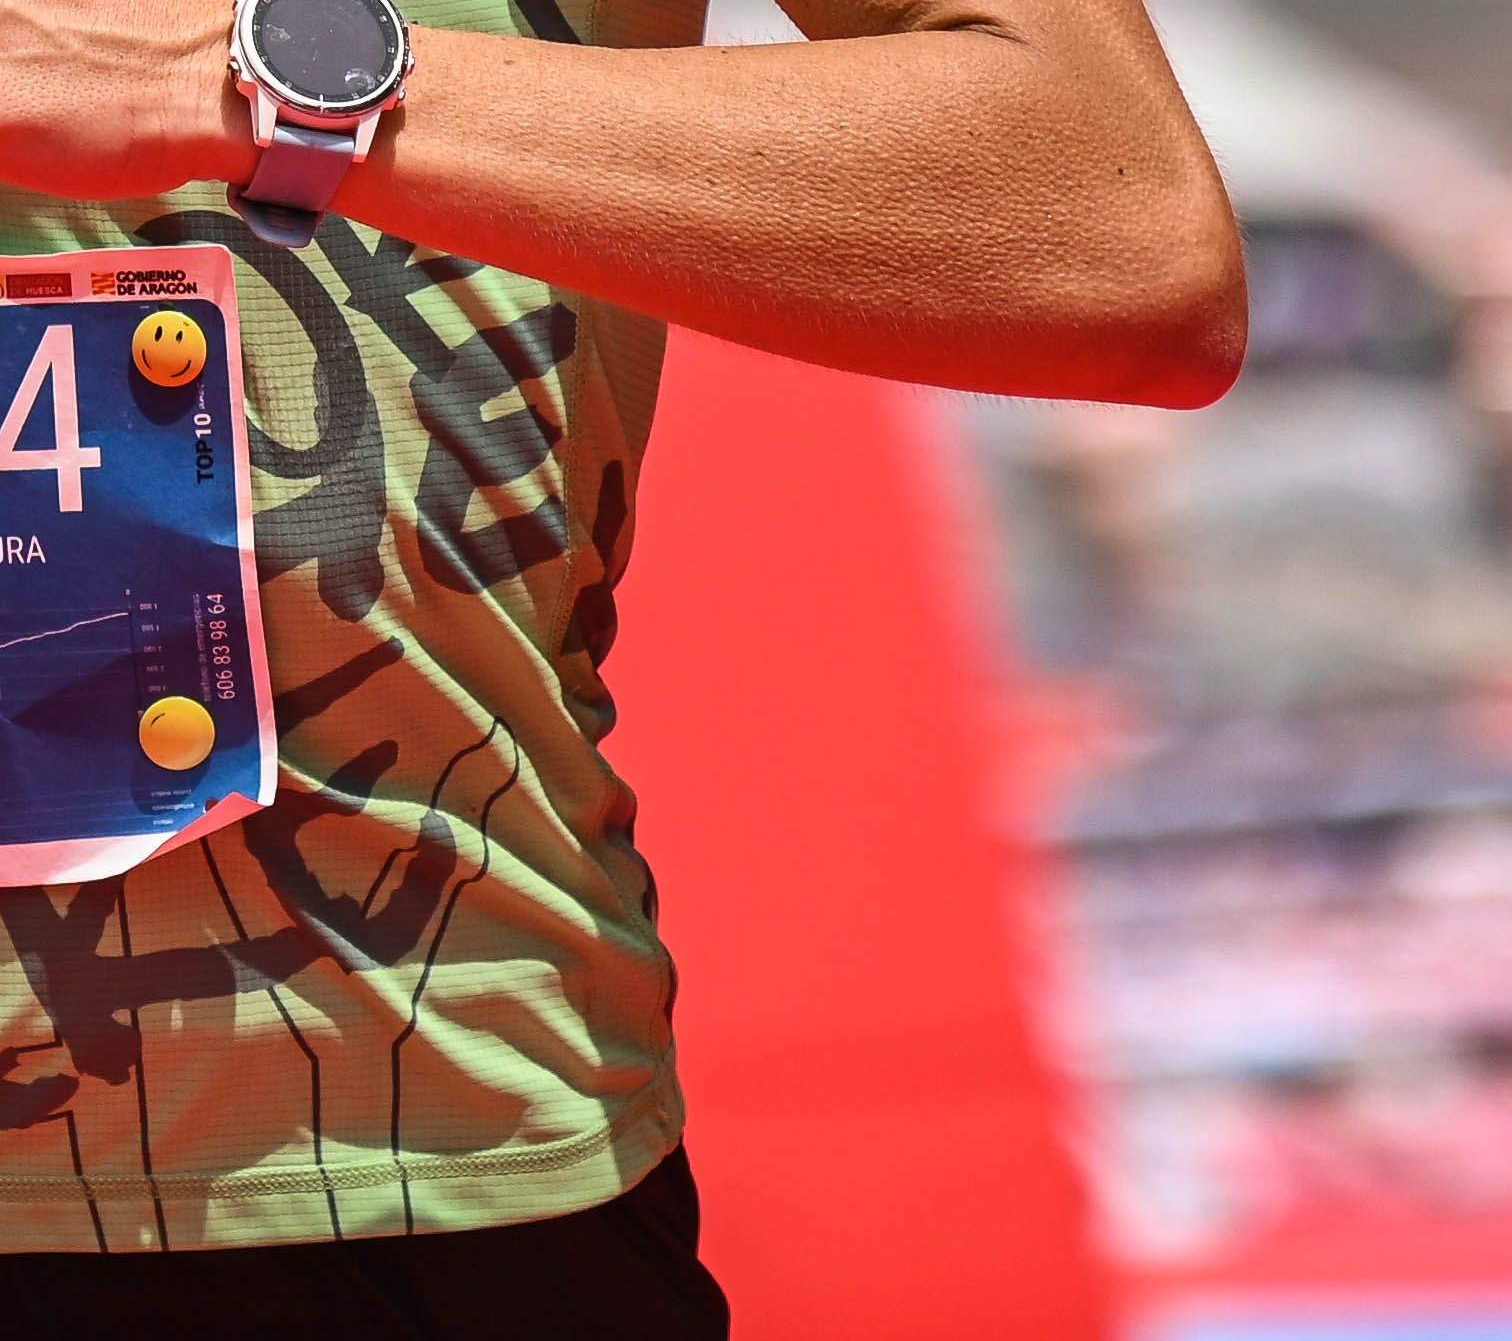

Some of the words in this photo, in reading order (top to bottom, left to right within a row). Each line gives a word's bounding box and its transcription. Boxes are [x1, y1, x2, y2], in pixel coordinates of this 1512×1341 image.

[116, 269, 187, 284] GOBIERNO
[117, 284, 136, 296] DE
[206, 592, 226, 615] 64
[209, 620, 228, 641] 98
[212, 644, 232, 665] 83
[215, 670, 236, 700] 606
